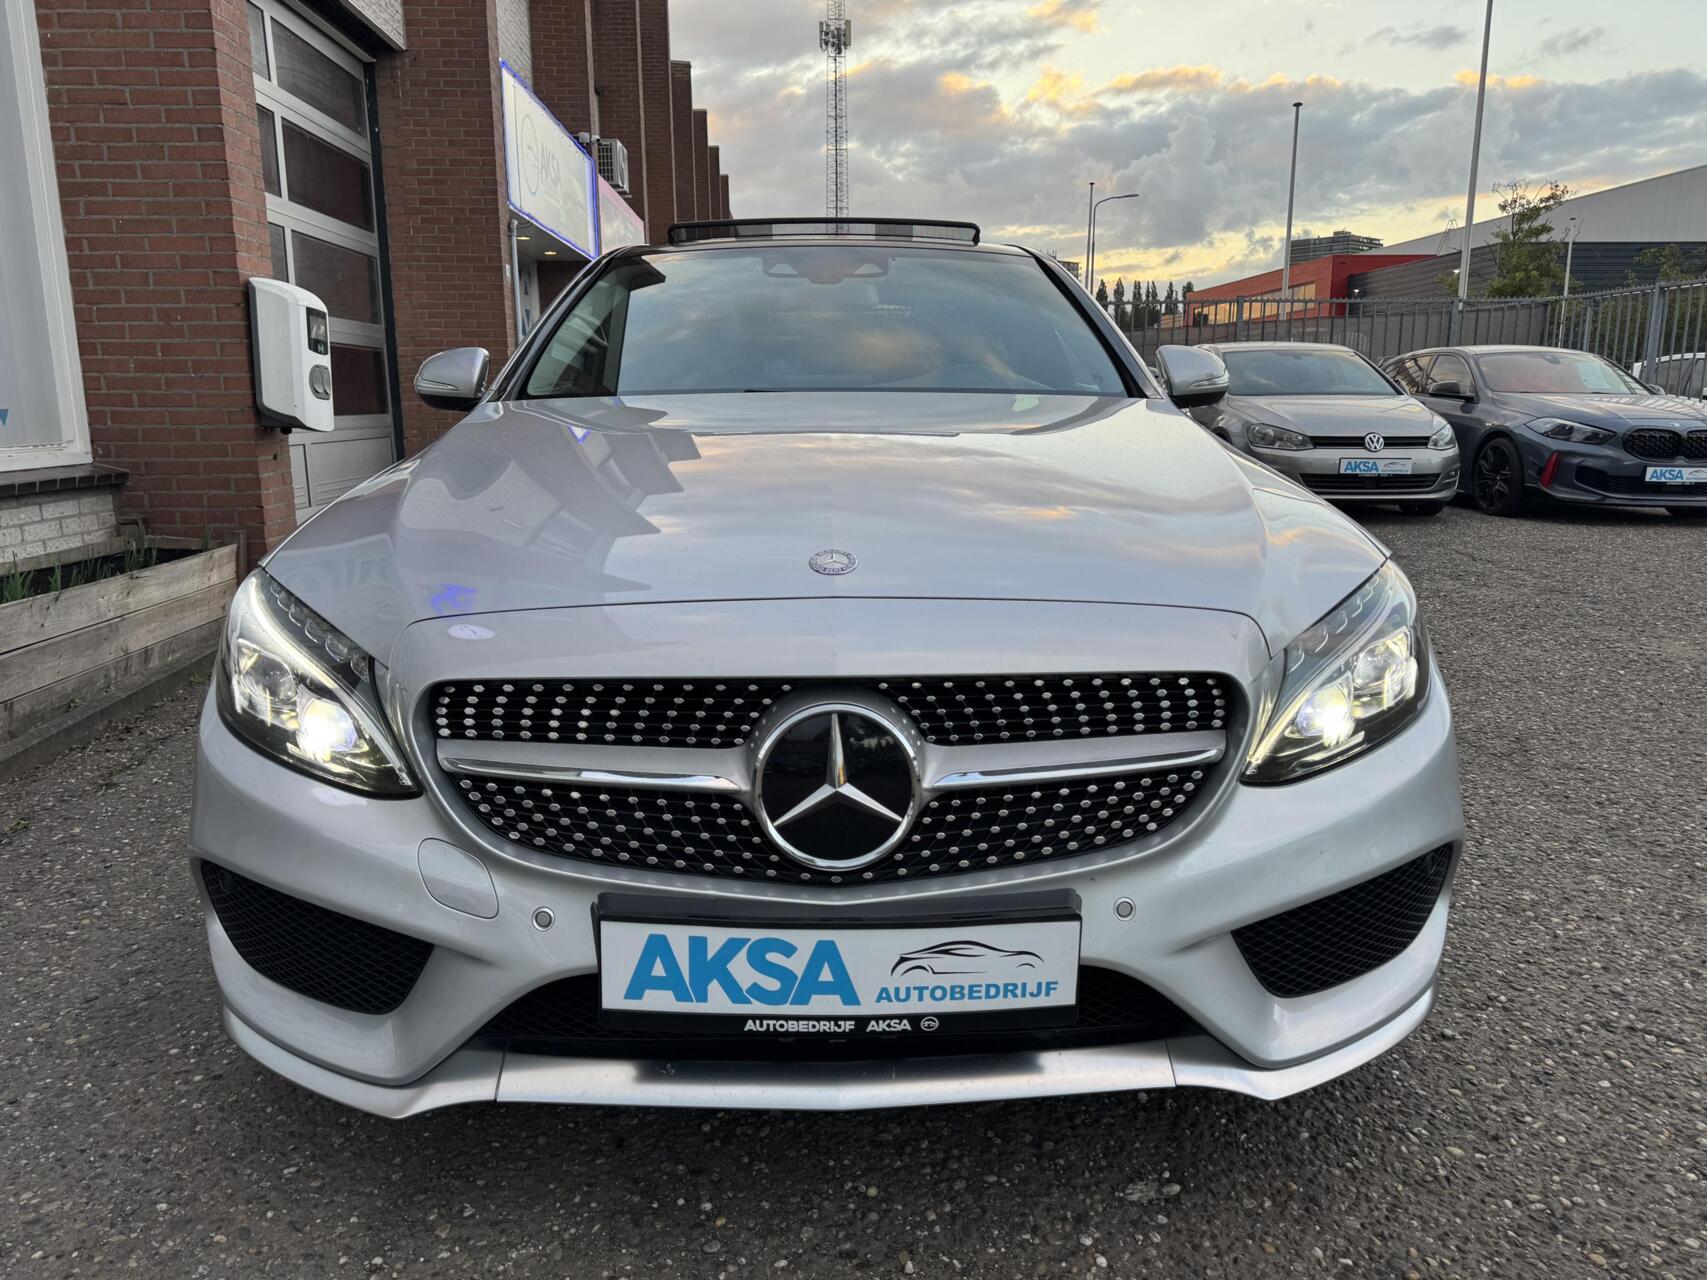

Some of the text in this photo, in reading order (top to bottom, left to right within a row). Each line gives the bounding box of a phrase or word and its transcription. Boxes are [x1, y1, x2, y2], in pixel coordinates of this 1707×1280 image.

[1344, 461, 1378, 472] AKSA
[1650, 469, 1683, 480] AKSA
[623, 934, 861, 1006] AKSA
[875, 981, 1058, 1003] AUTOBEDRIJF
[744, 1019, 912, 1032] AUTOBEDRIJF AKSA
